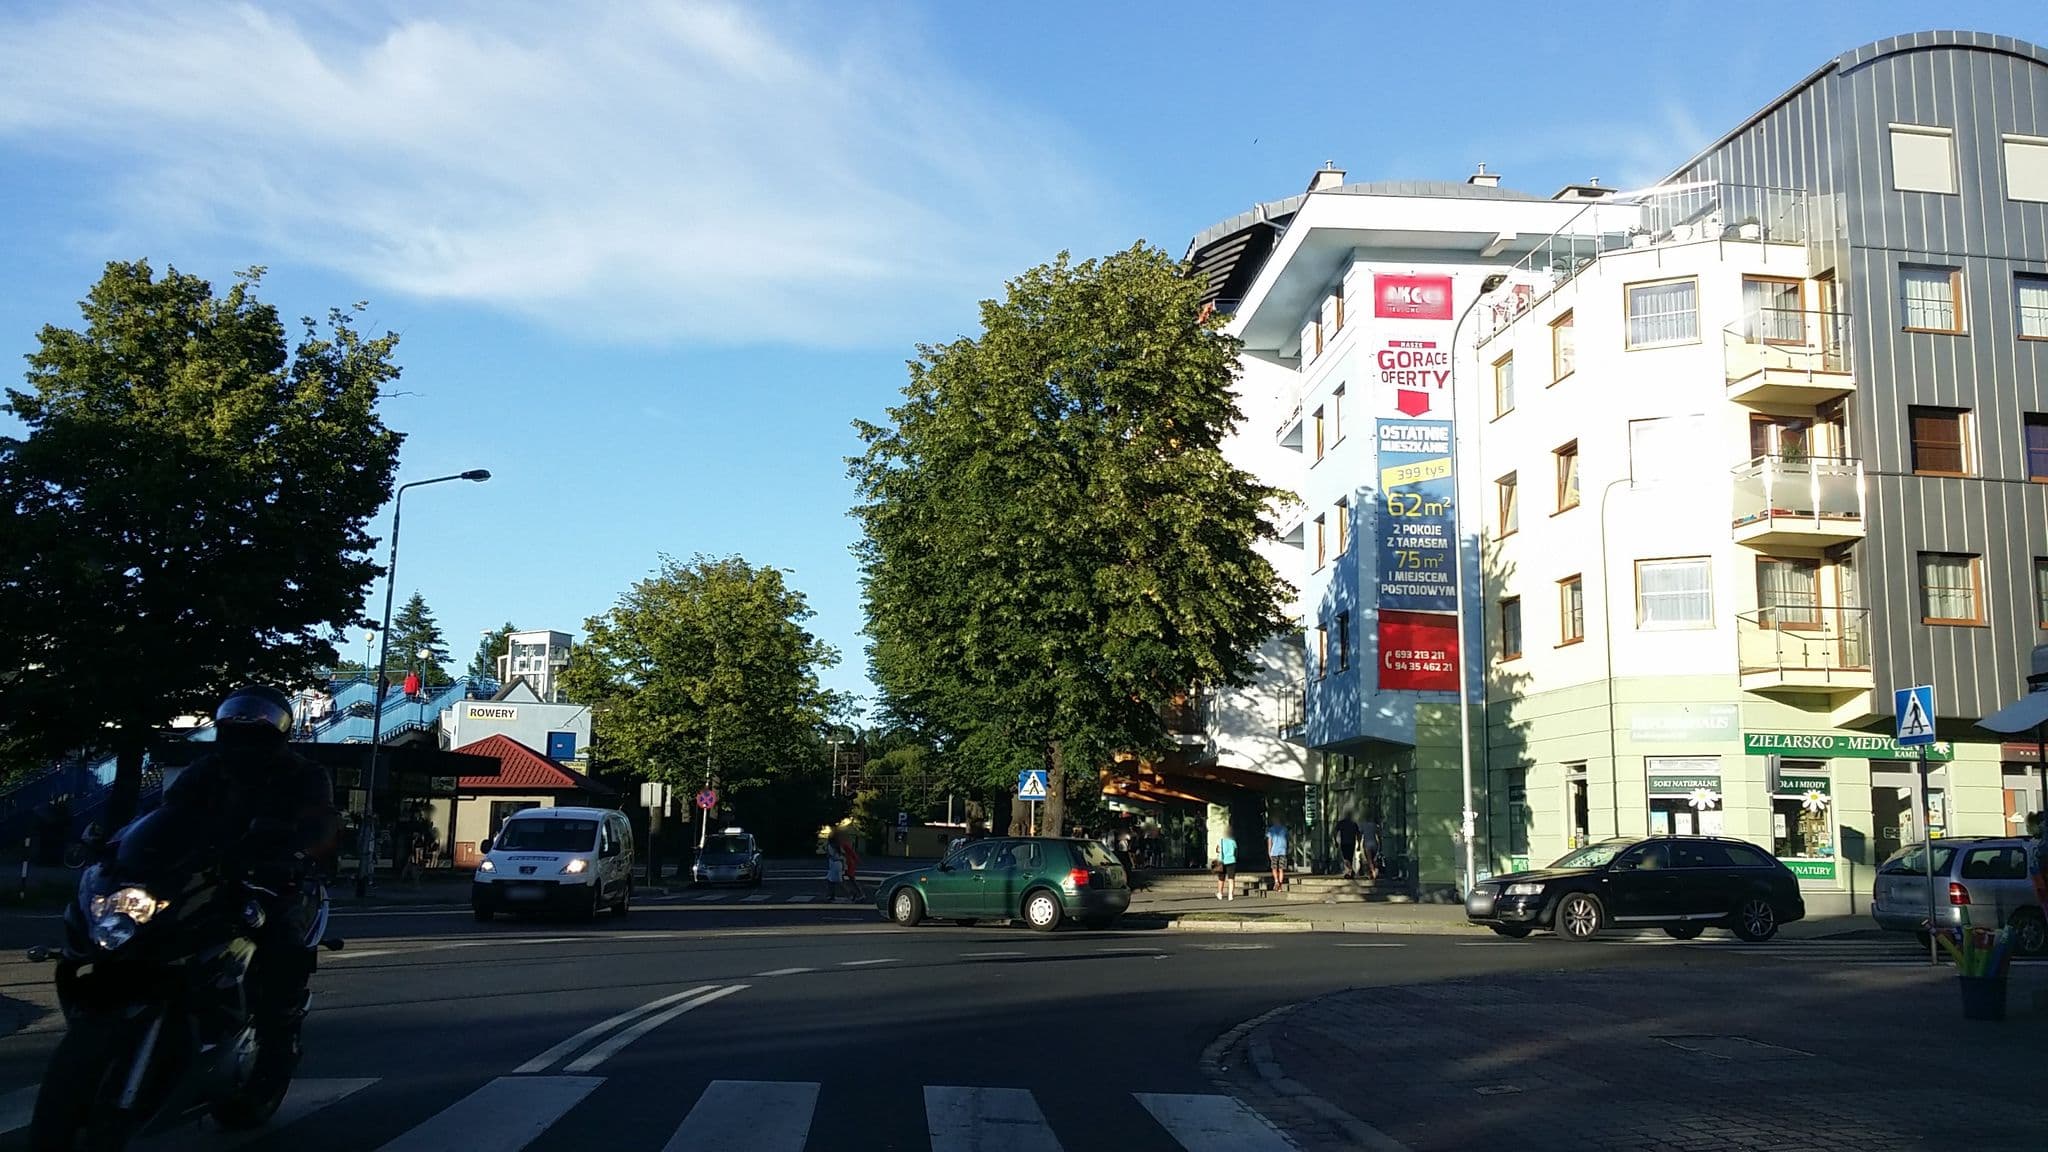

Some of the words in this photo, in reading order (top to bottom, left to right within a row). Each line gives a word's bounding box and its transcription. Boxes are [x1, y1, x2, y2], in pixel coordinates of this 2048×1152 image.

[1381, 370, 1450, 389] OFERTY
[1380, 425, 1448, 441] OSTATNIE
[1397, 467, 1421, 480] 399
[1426, 465, 1445, 477] tys
[1393, 524, 1401, 535] 2
[1402, 524, 1442, 536] POKOJE
[1386, 537, 1395, 547] Z
[1396, 537, 1449, 549] TARASEM
[1395, 550, 1421, 569] 75
[1394, 571, 1448, 583] MIEJSCEM
[1381, 584, 1456, 596] POSTOJOWYM
[1395, 650, 1412, 659] 693
[1414, 650, 1430, 660] 213
[1423, 662, 1441, 672] 462
[1442, 663, 1453, 672] 21
[470, 708, 515, 718] ROWERY
[1748, 734, 1834, 750] ZIELARSKO
[1847, 736, 1927, 752] MEDYC
[1799, 780, 1827, 788] MIODY
[1794, 866, 1832, 875] NATURY
